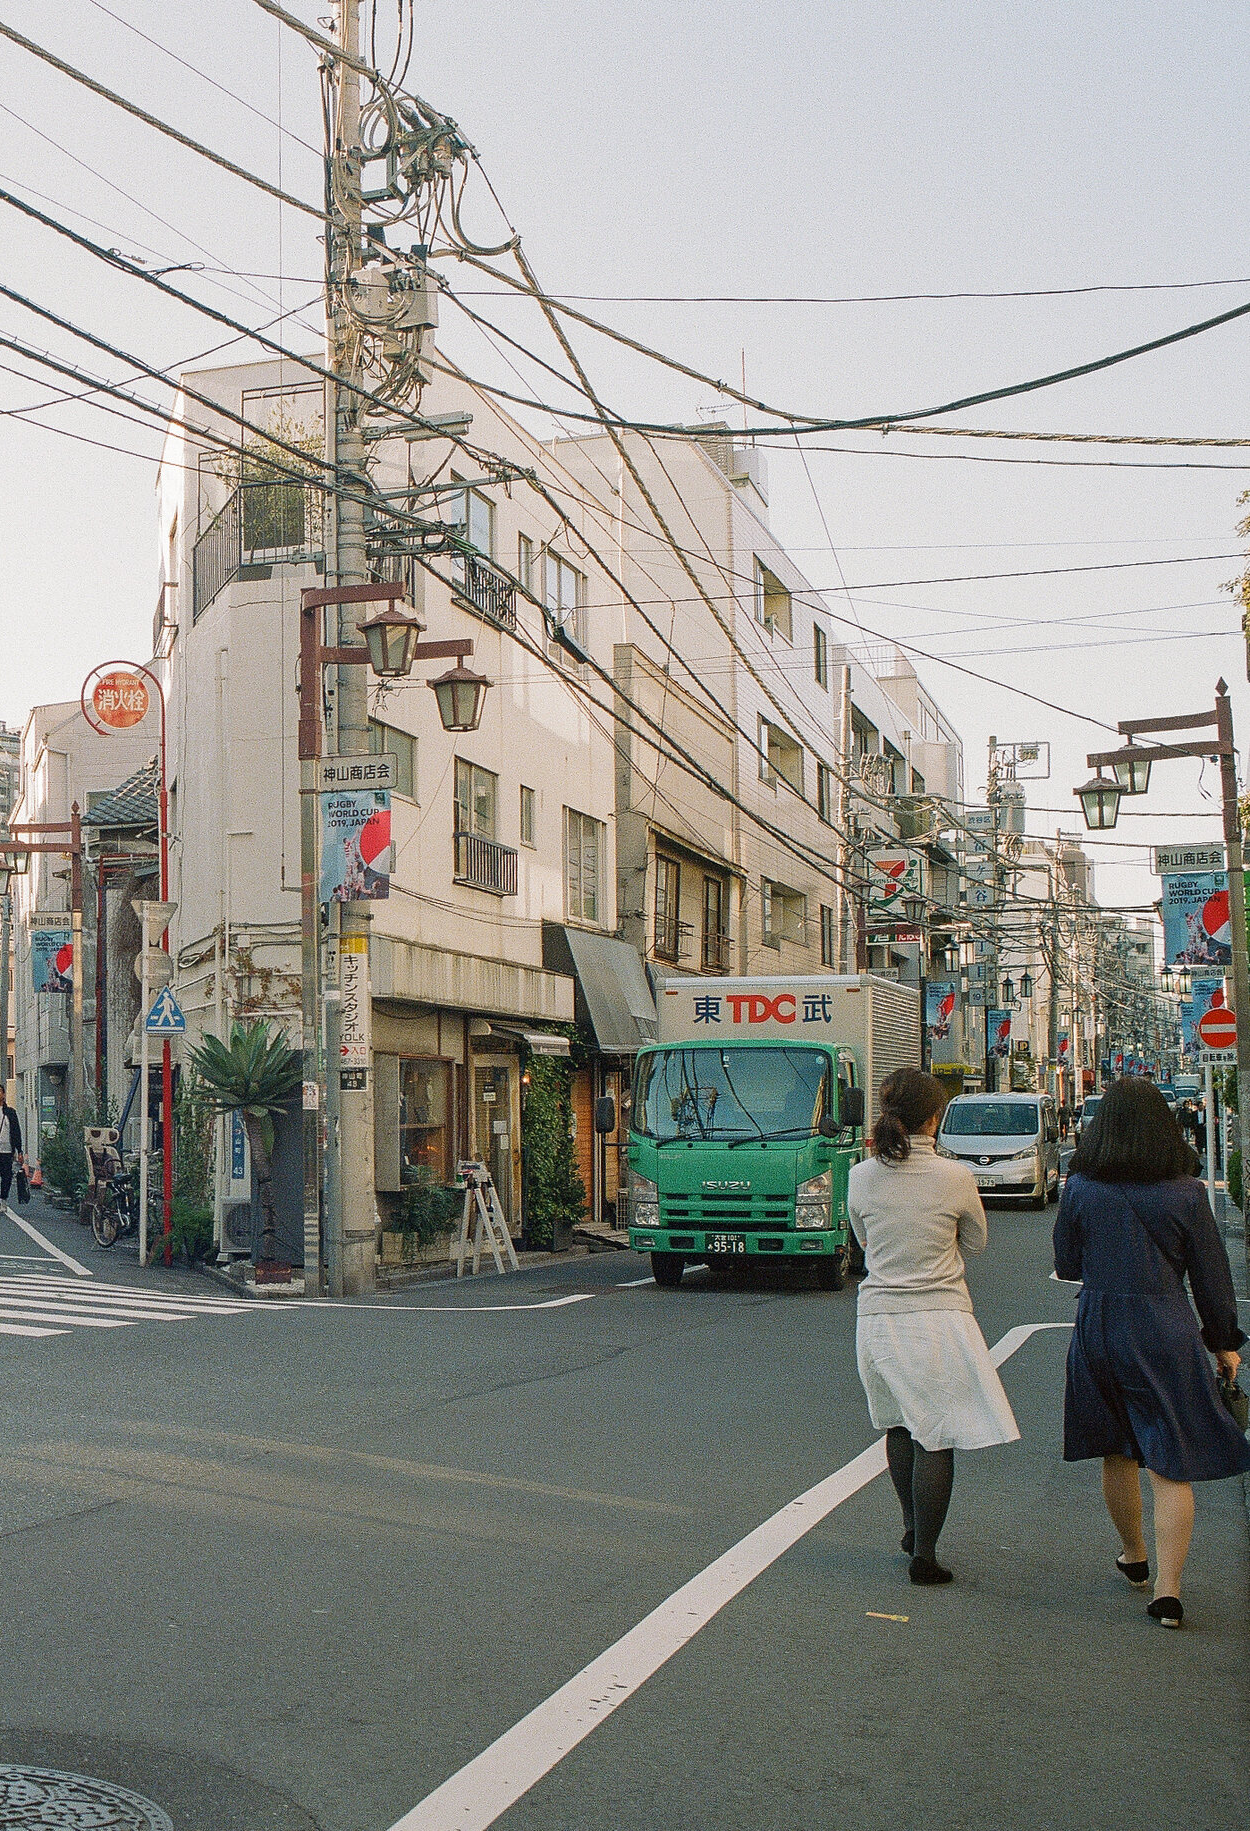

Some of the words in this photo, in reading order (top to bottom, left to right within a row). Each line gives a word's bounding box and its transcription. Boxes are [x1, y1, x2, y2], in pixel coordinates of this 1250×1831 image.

[97, 688, 145, 711] 消火栓
[323, 763, 390, 782] 神山商店会
[327, 800, 357, 810] RUGBY
[328, 810, 359, 819] WORLD
[361, 808, 380, 817] CUP
[350, 817, 380, 827] JAPAN
[1157, 850, 1222, 867] 神山商店会
[1168, 881, 1199, 889] RUGBY
[1168, 889, 1200, 897] WORLD
[1202, 888, 1220, 896] CUP
[1168, 897, 1191, 905] 2019,
[1192, 895, 1221, 904] JAPAN
[343, 954, 359, 1032] キッチンスタジオ
[693, 995, 722, 1024] 東
[726, 994, 796, 1024] TDC
[802, 994, 832, 1024] 武
[339, 1033, 364, 1042] YOLK
[350, 1046, 366, 1055] 入口
[702, 1181, 751, 1190] ISUZU
[714, 1241, 745, 1253] 95-18
